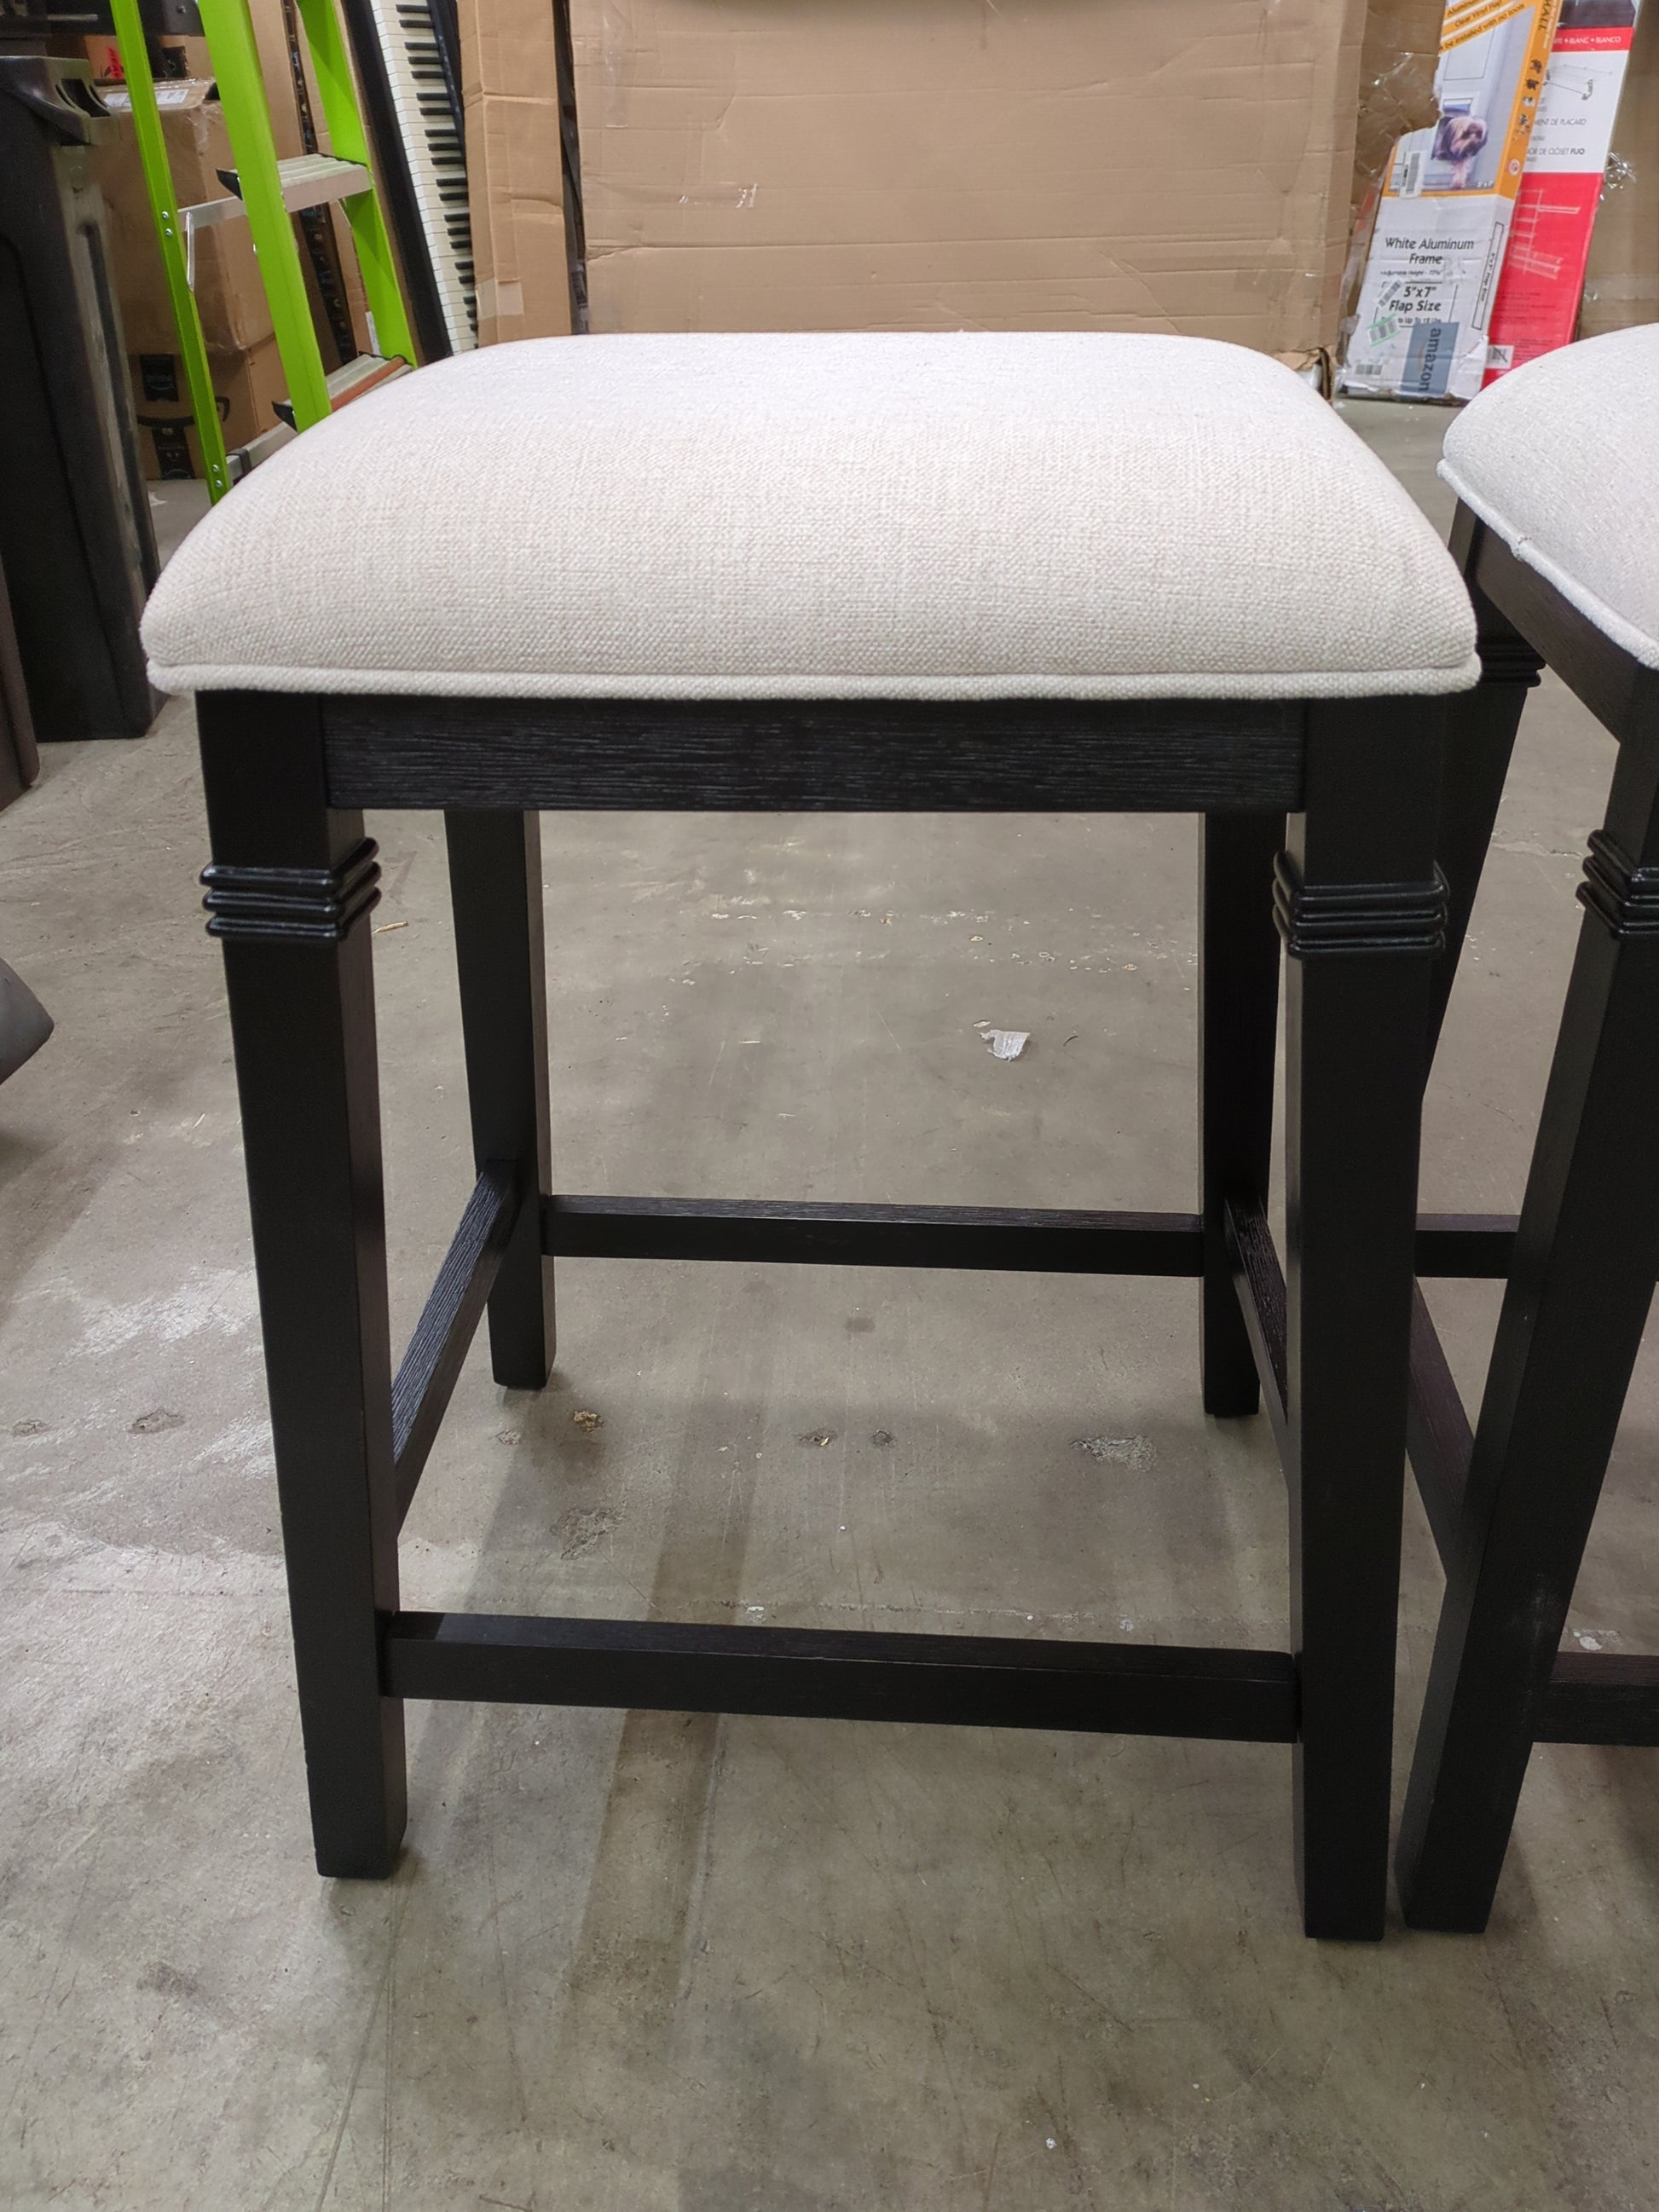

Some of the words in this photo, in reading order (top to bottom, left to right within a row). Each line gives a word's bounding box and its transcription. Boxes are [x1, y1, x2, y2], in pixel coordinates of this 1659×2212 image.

[1385, 237, 1417, 250] White
[1418, 238, 1475, 251] Aluminum
[1408, 253, 1443, 265] Frame
[1389, 299, 1413, 314] Flap
[1415, 300, 1442, 312] Size
[1418, 327, 1442, 392] amazon
